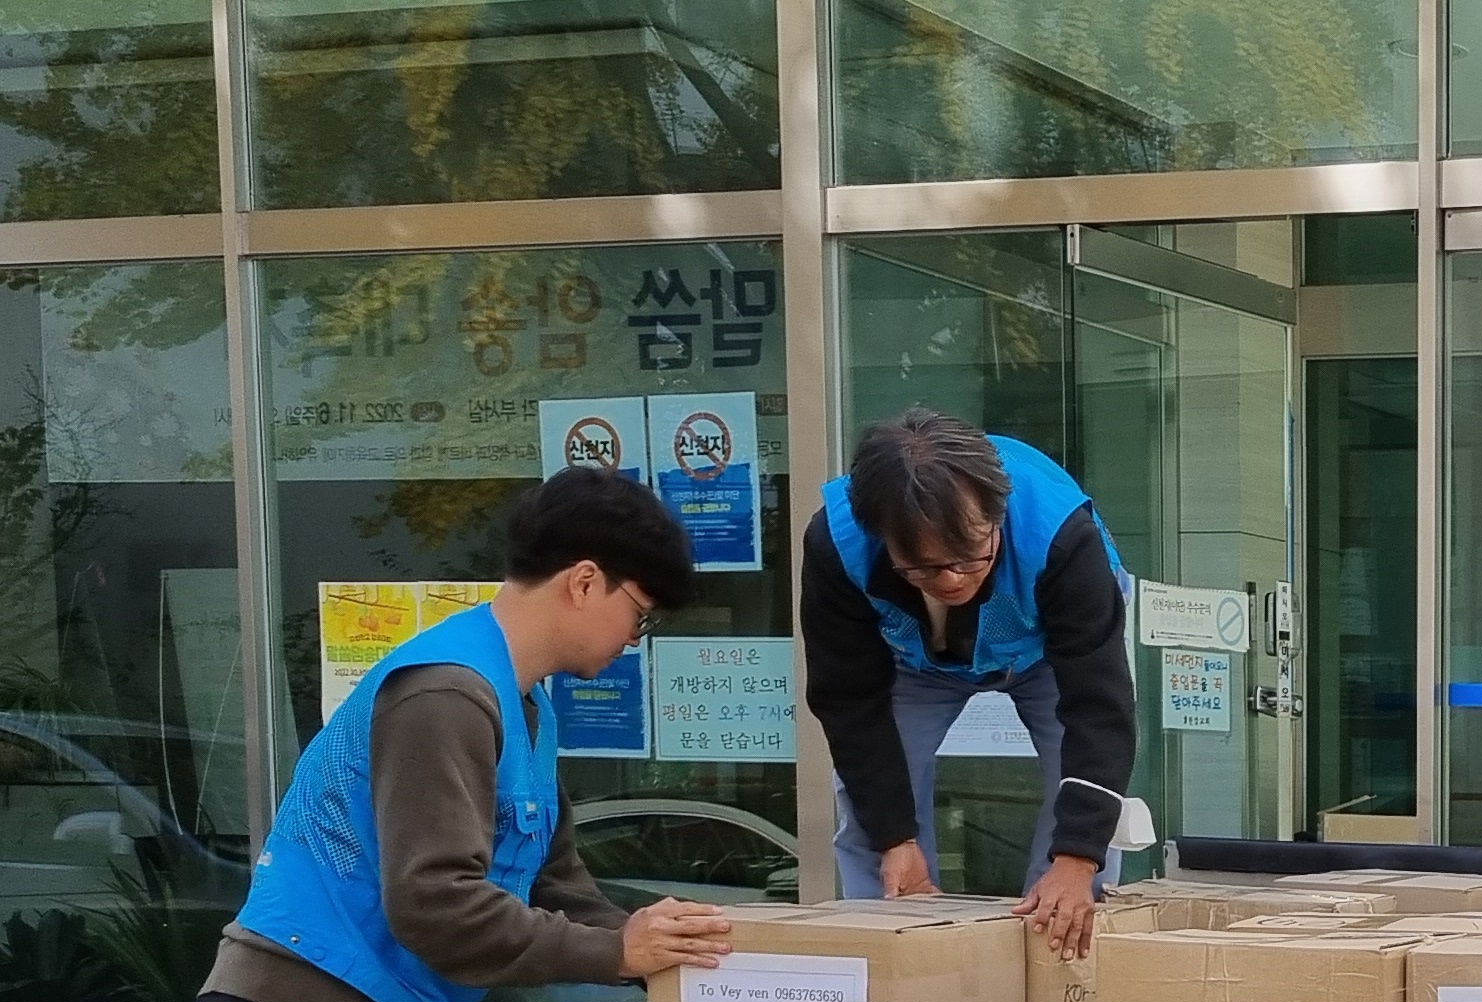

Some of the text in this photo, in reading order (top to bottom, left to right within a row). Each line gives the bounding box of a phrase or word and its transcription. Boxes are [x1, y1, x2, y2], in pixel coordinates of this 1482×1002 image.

[570, 440, 614, 461] 신천지
[680, 434, 725, 457] 신천지
[698, 648, 762, 667] 월요일은
[670, 676, 788, 694] 개방하지 않으며
[662, 704, 797, 723] 평일은 오후 7시에
[680, 732, 784, 750] 문을 닫습니다
[699, 983, 844, 1002] To Vey ven 0963763630
